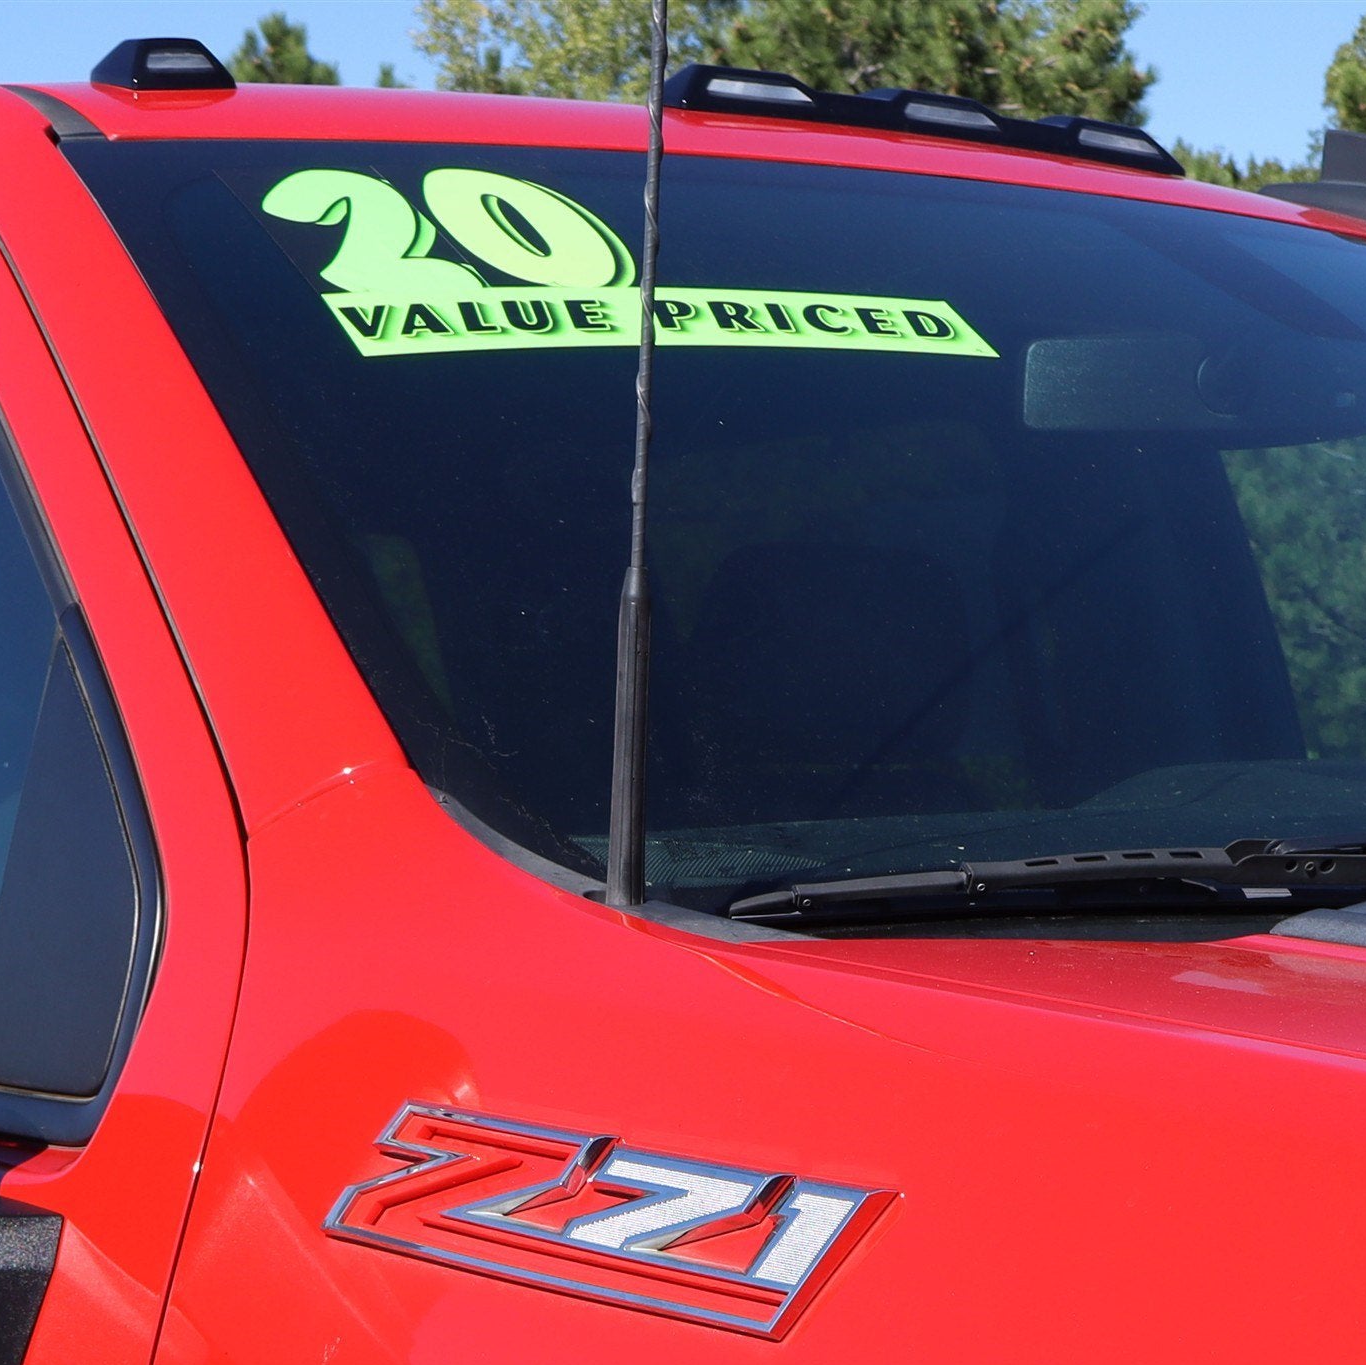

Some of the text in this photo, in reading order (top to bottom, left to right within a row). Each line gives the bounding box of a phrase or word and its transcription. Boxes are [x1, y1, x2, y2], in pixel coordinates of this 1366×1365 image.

[262, 168, 635, 290] 20
[338, 297, 960, 341] VALUE PRICED
[323, 1098, 901, 1342] Z71
